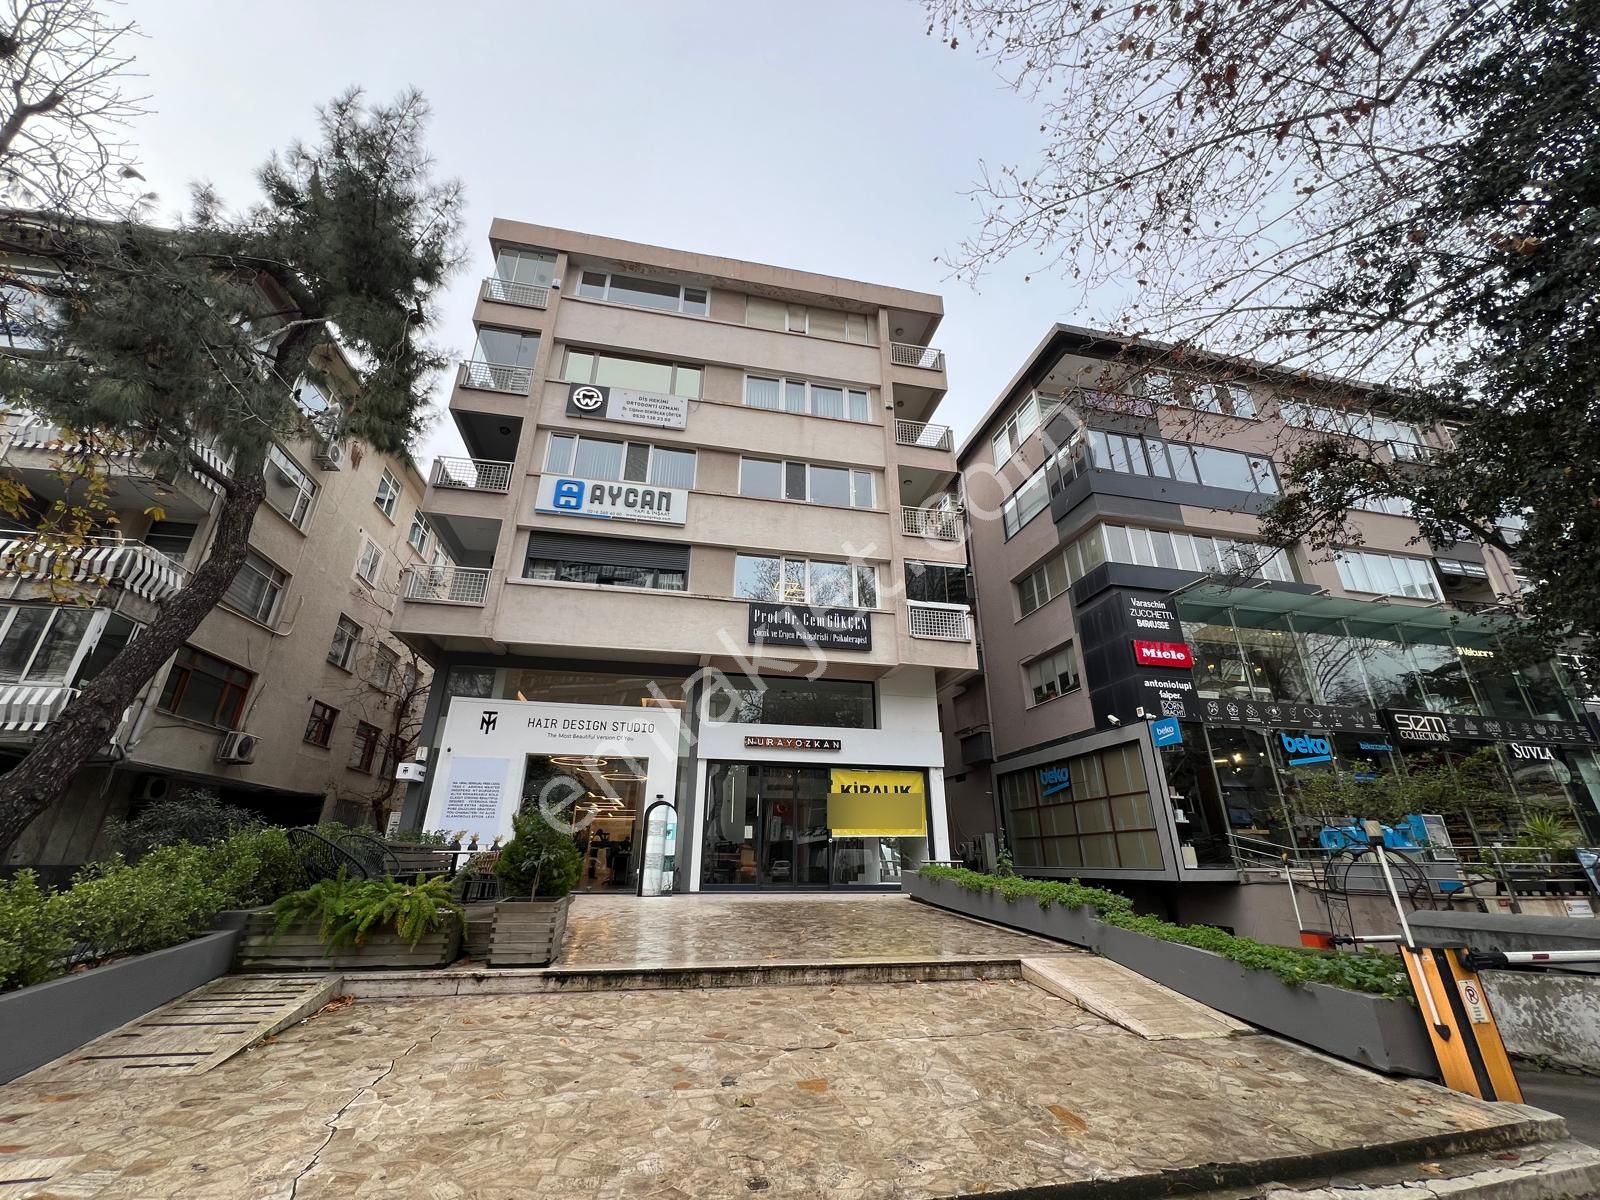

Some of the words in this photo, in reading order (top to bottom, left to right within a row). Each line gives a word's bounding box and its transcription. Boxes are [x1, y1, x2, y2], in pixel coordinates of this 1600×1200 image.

[590, 485, 671, 511] AYCAN
[1130, 597, 1166, 609] Varaschin
[754, 608, 782, 624] Prof.
[784, 611, 800, 626] Dr.
[803, 613, 825, 627] Cem
[827, 613, 868, 632] GÖKÇEN
[1141, 647, 1186, 660] Miele
[1144, 679, 1192, 691] antoniolupi
[527, 717, 558, 729] HAIR
[562, 719, 607, 731] DESIGN
[611, 721, 655, 734] STUDIO
[1157, 725, 1174, 736] beko
[1280, 731, 1330, 754] beko
[1400, 730, 1450, 742] COLLECTIONS
[1040, 766, 1069, 785] beko
